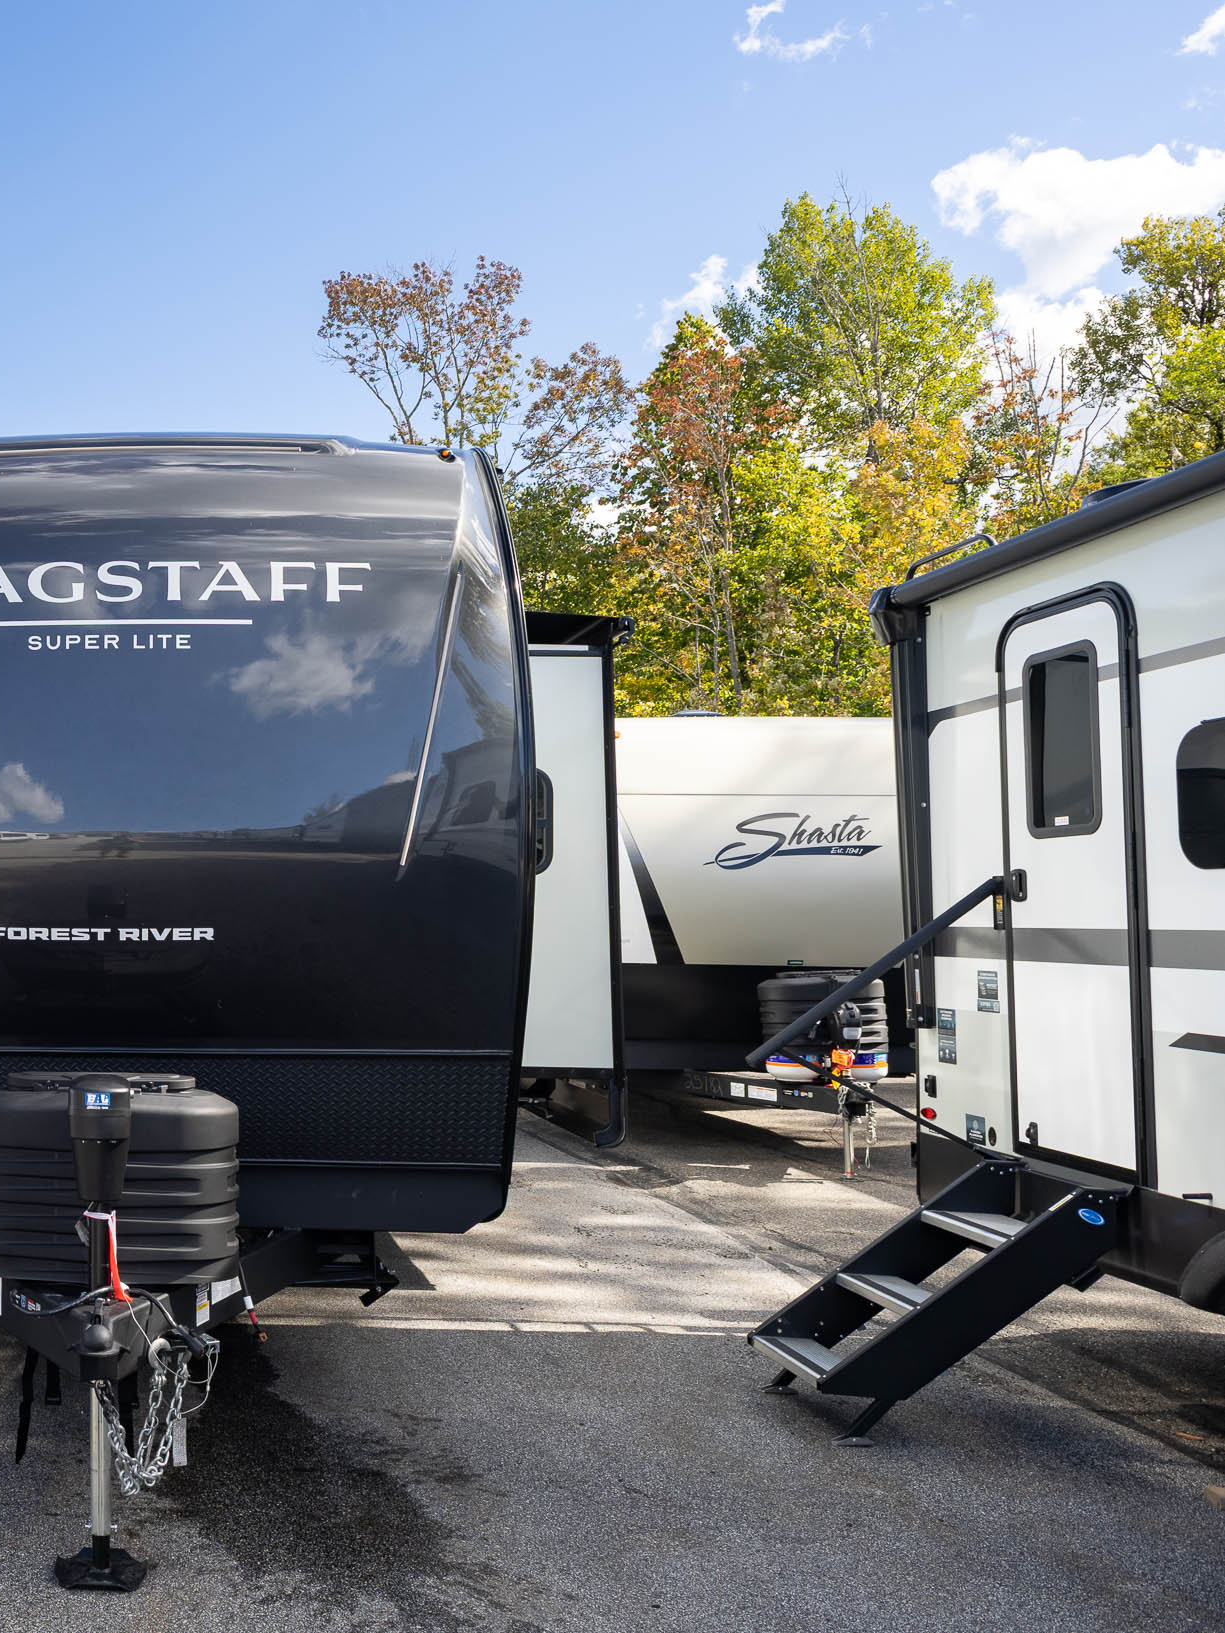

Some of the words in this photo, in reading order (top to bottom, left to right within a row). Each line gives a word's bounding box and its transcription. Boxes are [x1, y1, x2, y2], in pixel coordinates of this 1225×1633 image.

[27, 634, 121, 650] SUPER
[132, 633, 192, 650] LITE
[714, 812, 872, 870] Shasta
[117, 927, 216, 942] RIVER
